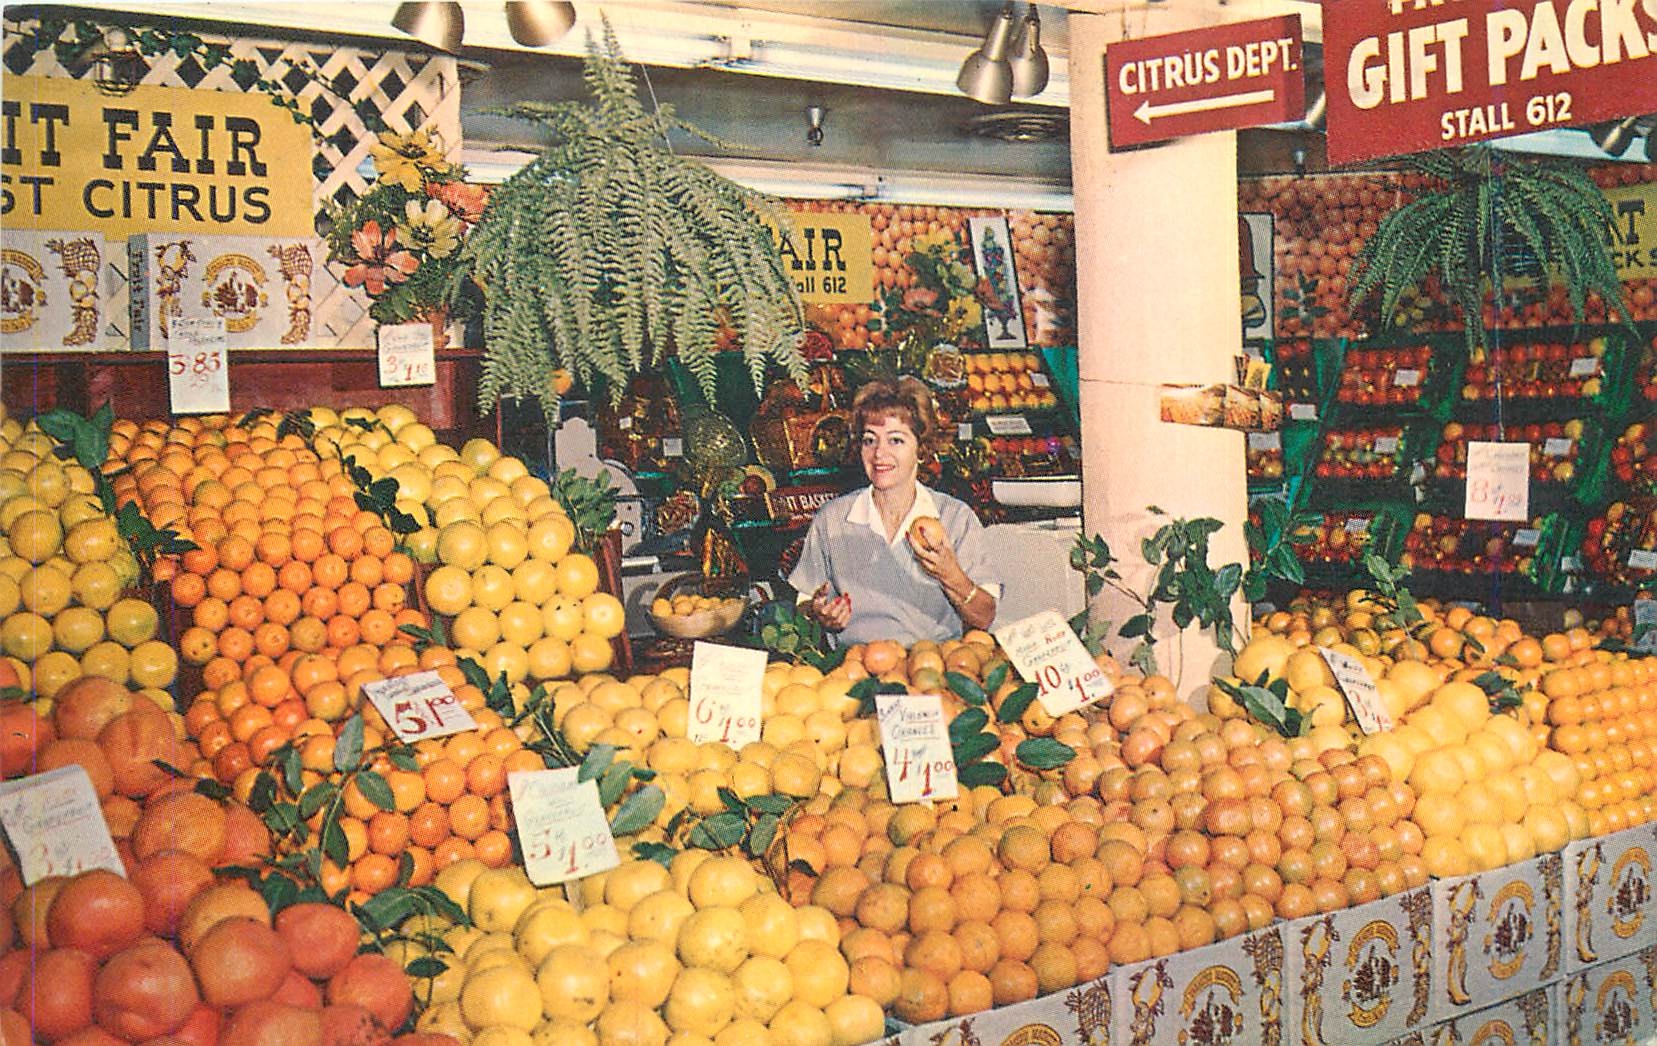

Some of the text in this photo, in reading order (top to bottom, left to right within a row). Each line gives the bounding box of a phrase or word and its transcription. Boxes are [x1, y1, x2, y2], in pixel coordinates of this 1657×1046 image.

[1119, 38, 1297, 95] CITRUS DEPT.
[1347, 18, 1469, 109] GIFT
[1441, 92, 1572, 140] STALL 612
[102, 108, 267, 177] FAIR
[82, 178, 271, 224] CITRUS
[768, 226, 846, 271] AIR
[796, 276, 847, 293] all 612
[893, 747, 912, 783] 4
